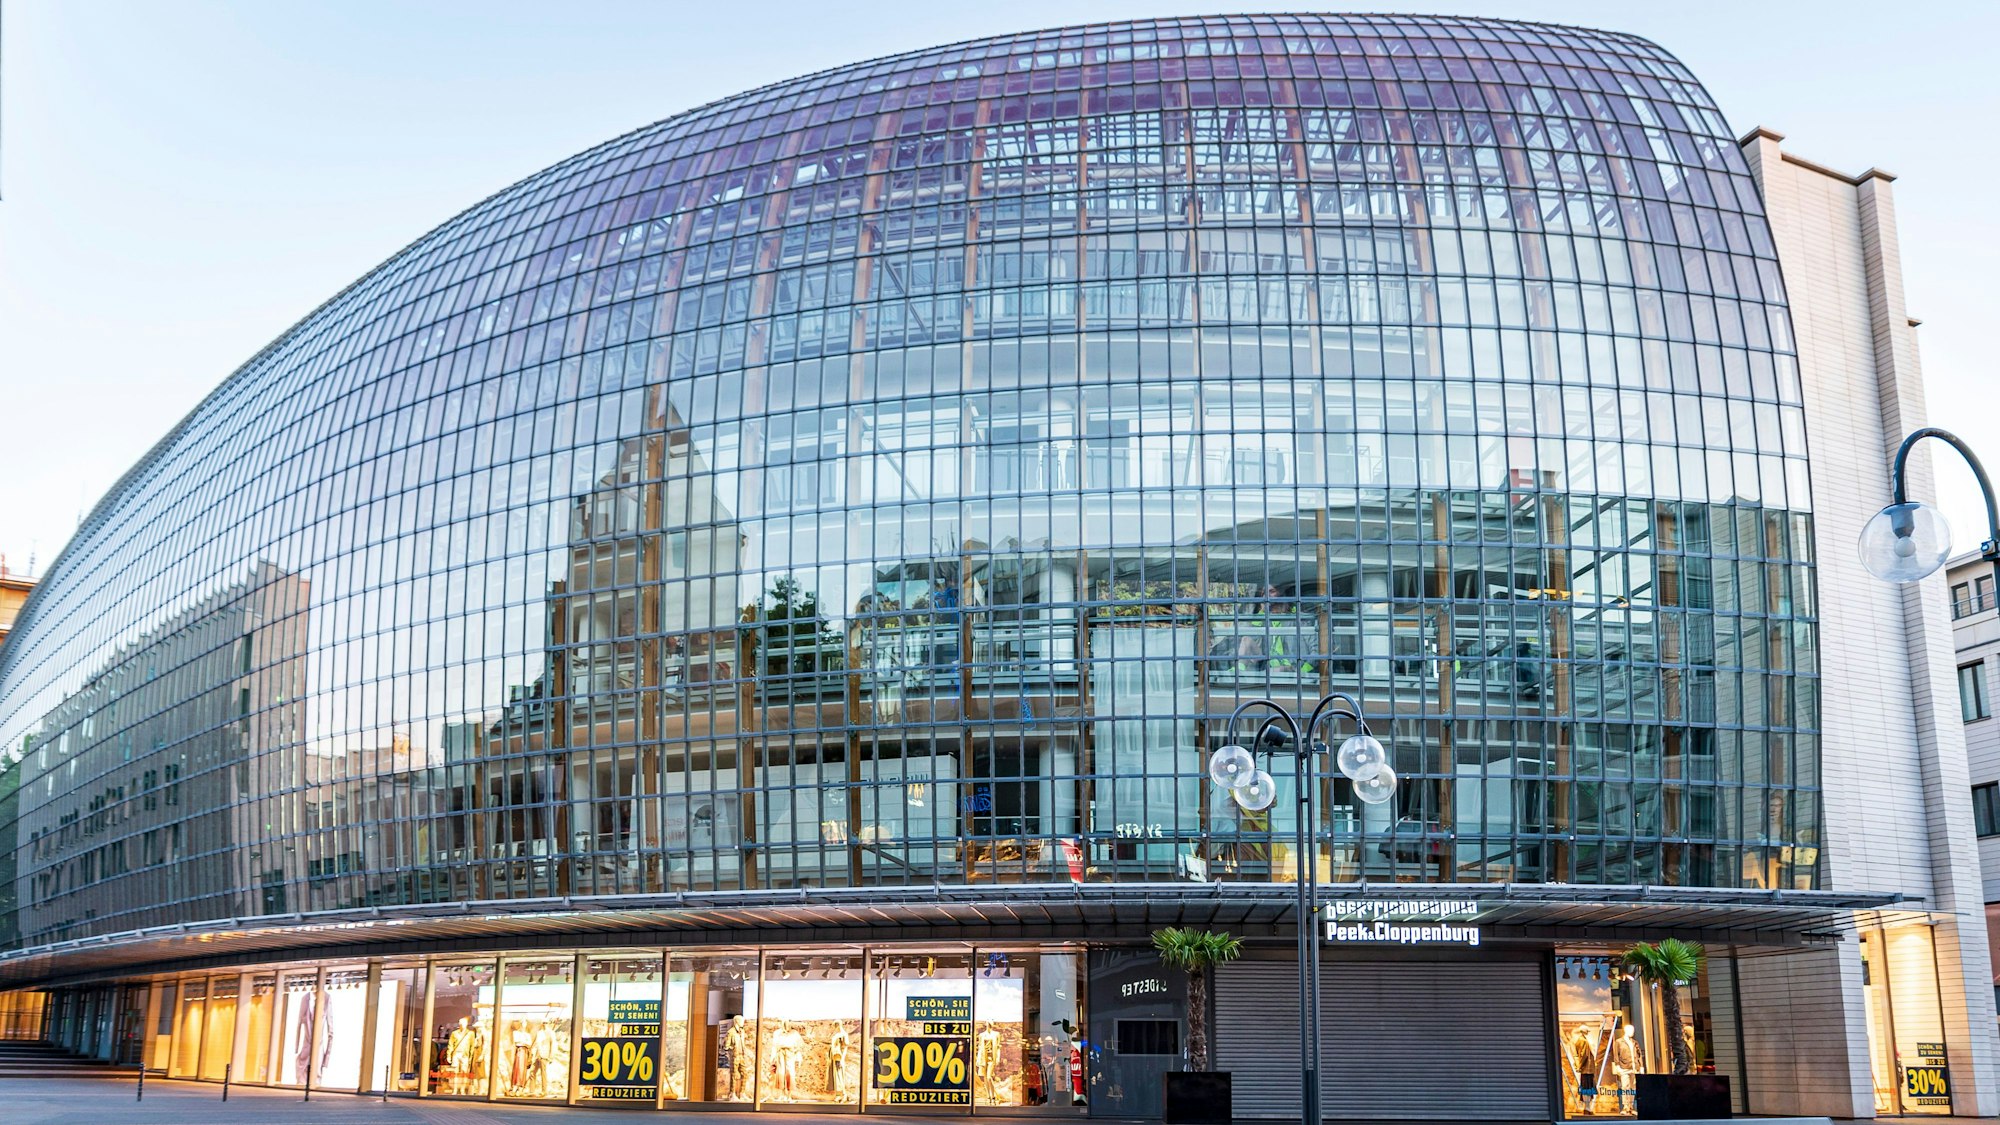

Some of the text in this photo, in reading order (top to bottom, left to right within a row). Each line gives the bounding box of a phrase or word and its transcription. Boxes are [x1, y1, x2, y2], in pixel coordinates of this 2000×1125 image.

[1326, 922, 1480, 946] Peek&Cloppenburg
[610, 1002, 658, 1012] SCHÖN, SIE
[909, 998, 968, 1008] SCHÖN, SIE
[914, 1009, 968, 1017] ZU SEHEN!
[621, 1026, 659, 1034] BIS ZU
[924, 1024, 969, 1033] BIS ZU
[582, 1041, 654, 1081] 30%
[877, 1041, 966, 1084] 30%
[1907, 1069, 1946, 1094] 30%
[593, 1088, 655, 1097] REDUZIERT
[891, 1092, 968, 1102] REDUZIERT
